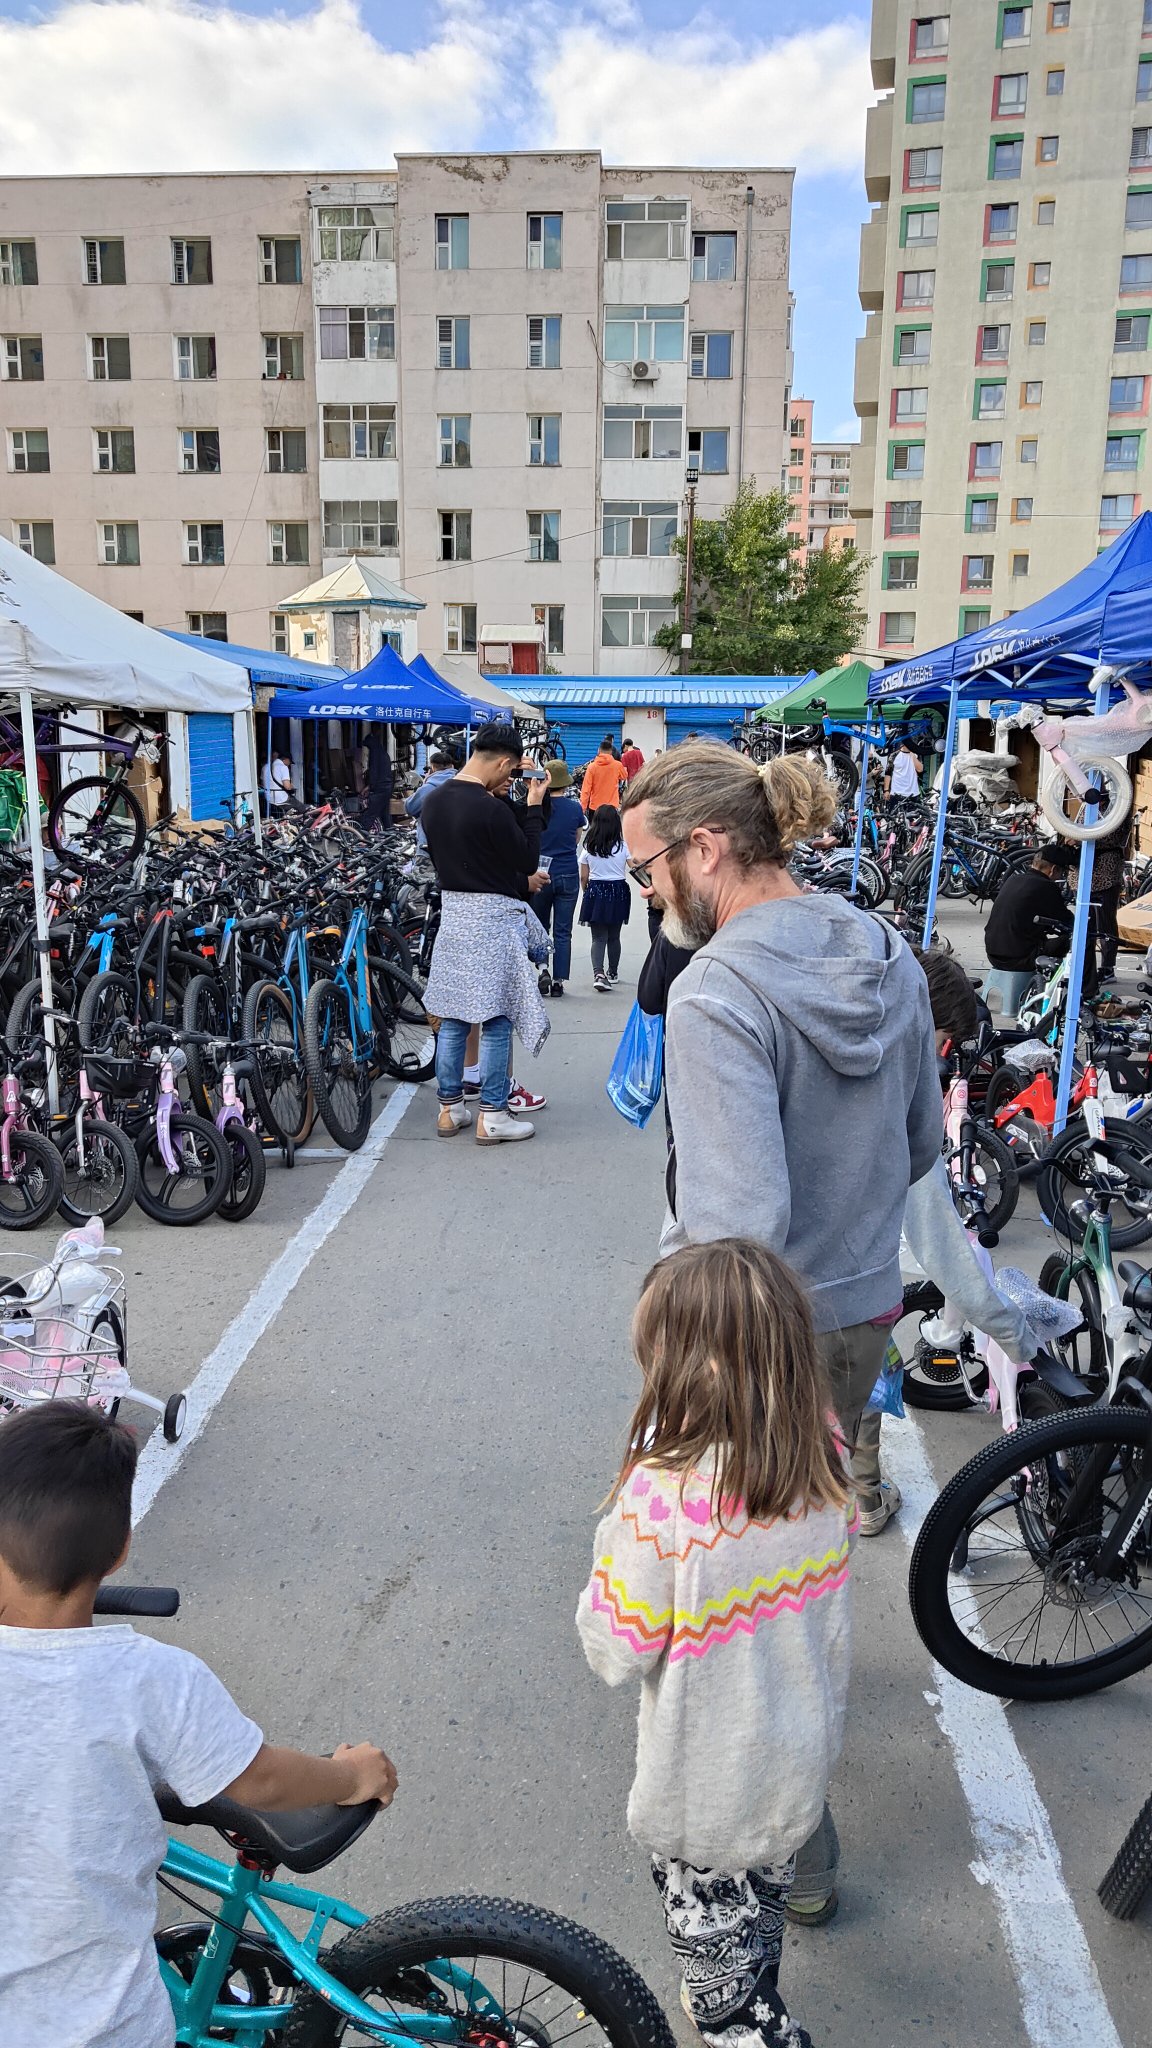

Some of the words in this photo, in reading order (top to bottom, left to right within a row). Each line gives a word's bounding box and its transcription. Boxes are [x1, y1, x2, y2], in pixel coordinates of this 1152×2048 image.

[308, 705, 373, 715] LOSK
[375, 706, 432, 720] 洛仕克自行车
[647, 710, 658, 719] 18
